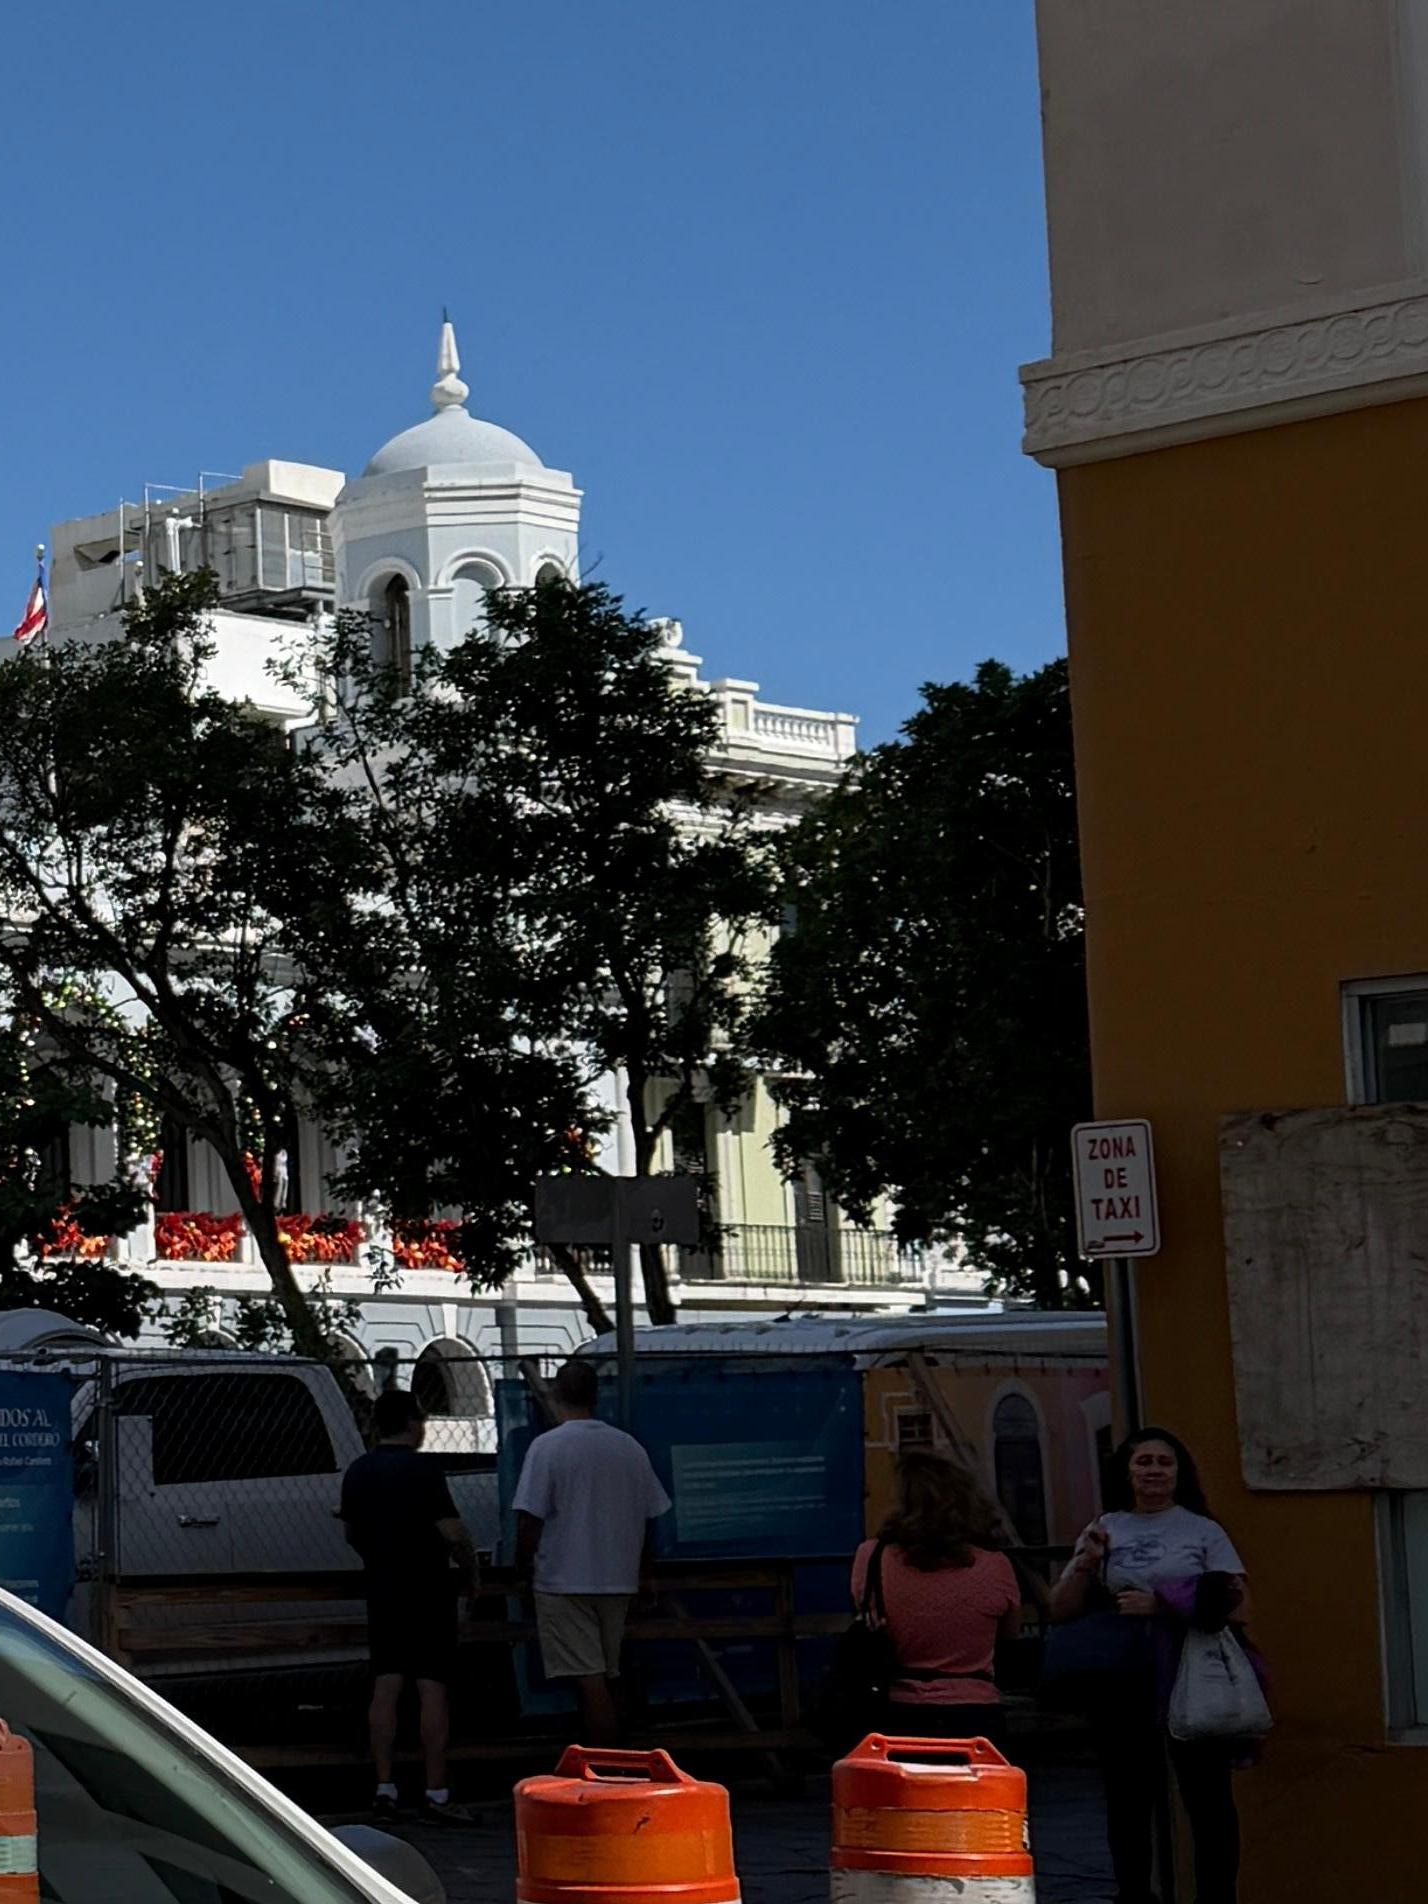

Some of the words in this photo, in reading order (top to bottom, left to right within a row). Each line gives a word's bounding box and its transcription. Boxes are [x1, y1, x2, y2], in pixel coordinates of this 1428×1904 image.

[1088, 1136, 1136, 1159] ZONA
[1105, 1168, 1128, 1189] DE
[1092, 1196, 1140, 1220] TAXI
[32, 1408, 53, 1428] AL
